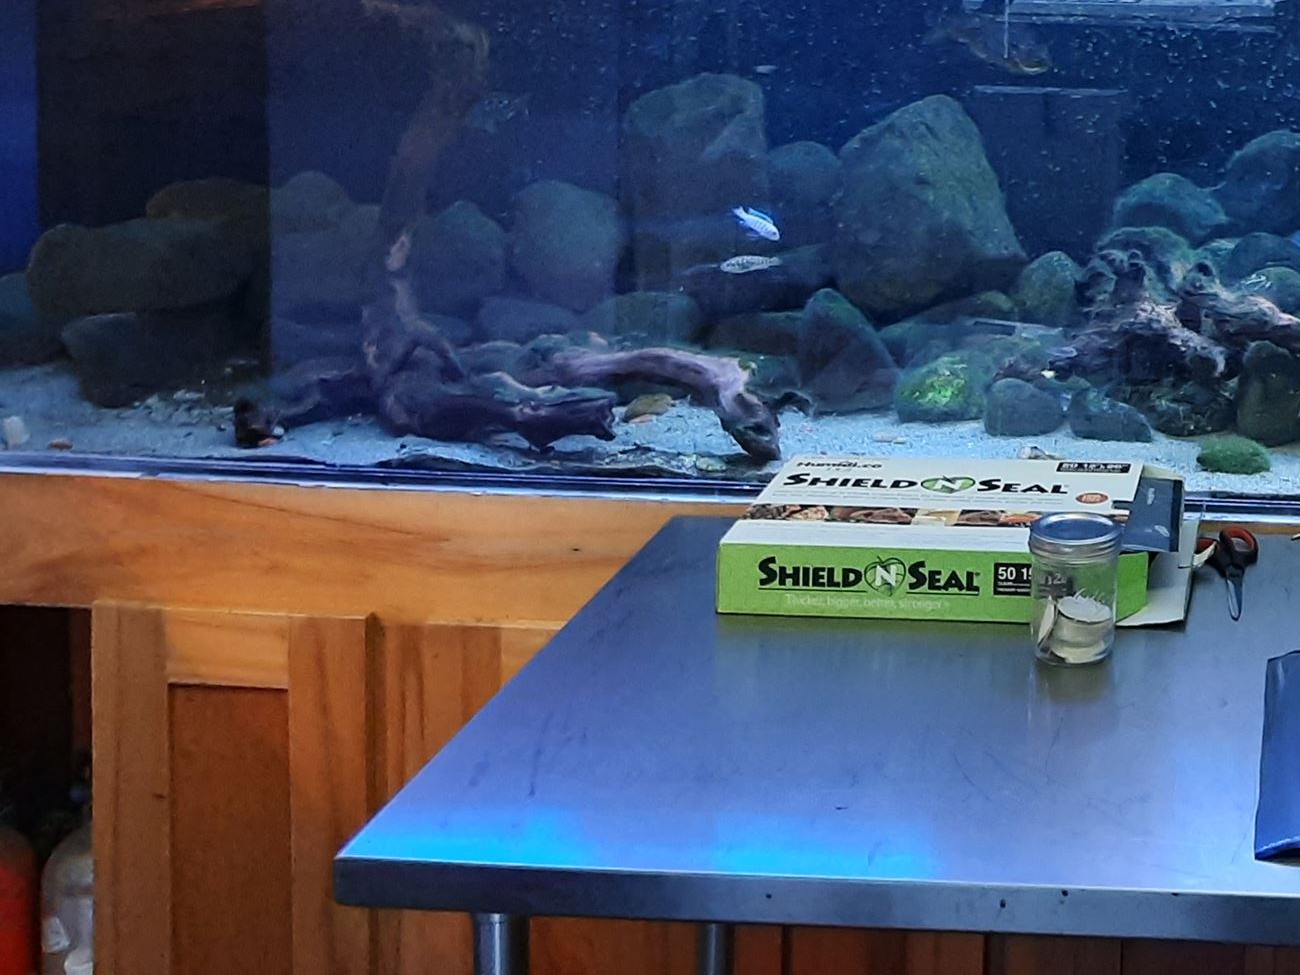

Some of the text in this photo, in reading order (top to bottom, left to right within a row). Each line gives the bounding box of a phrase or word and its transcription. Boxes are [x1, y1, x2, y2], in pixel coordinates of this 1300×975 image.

[783, 473, 917, 489] SHIELD
[977, 479, 1068, 494] SEAL
[758, 556, 980, 592] SHIELD N SEAL
[998, 566, 1017, 580] 50
